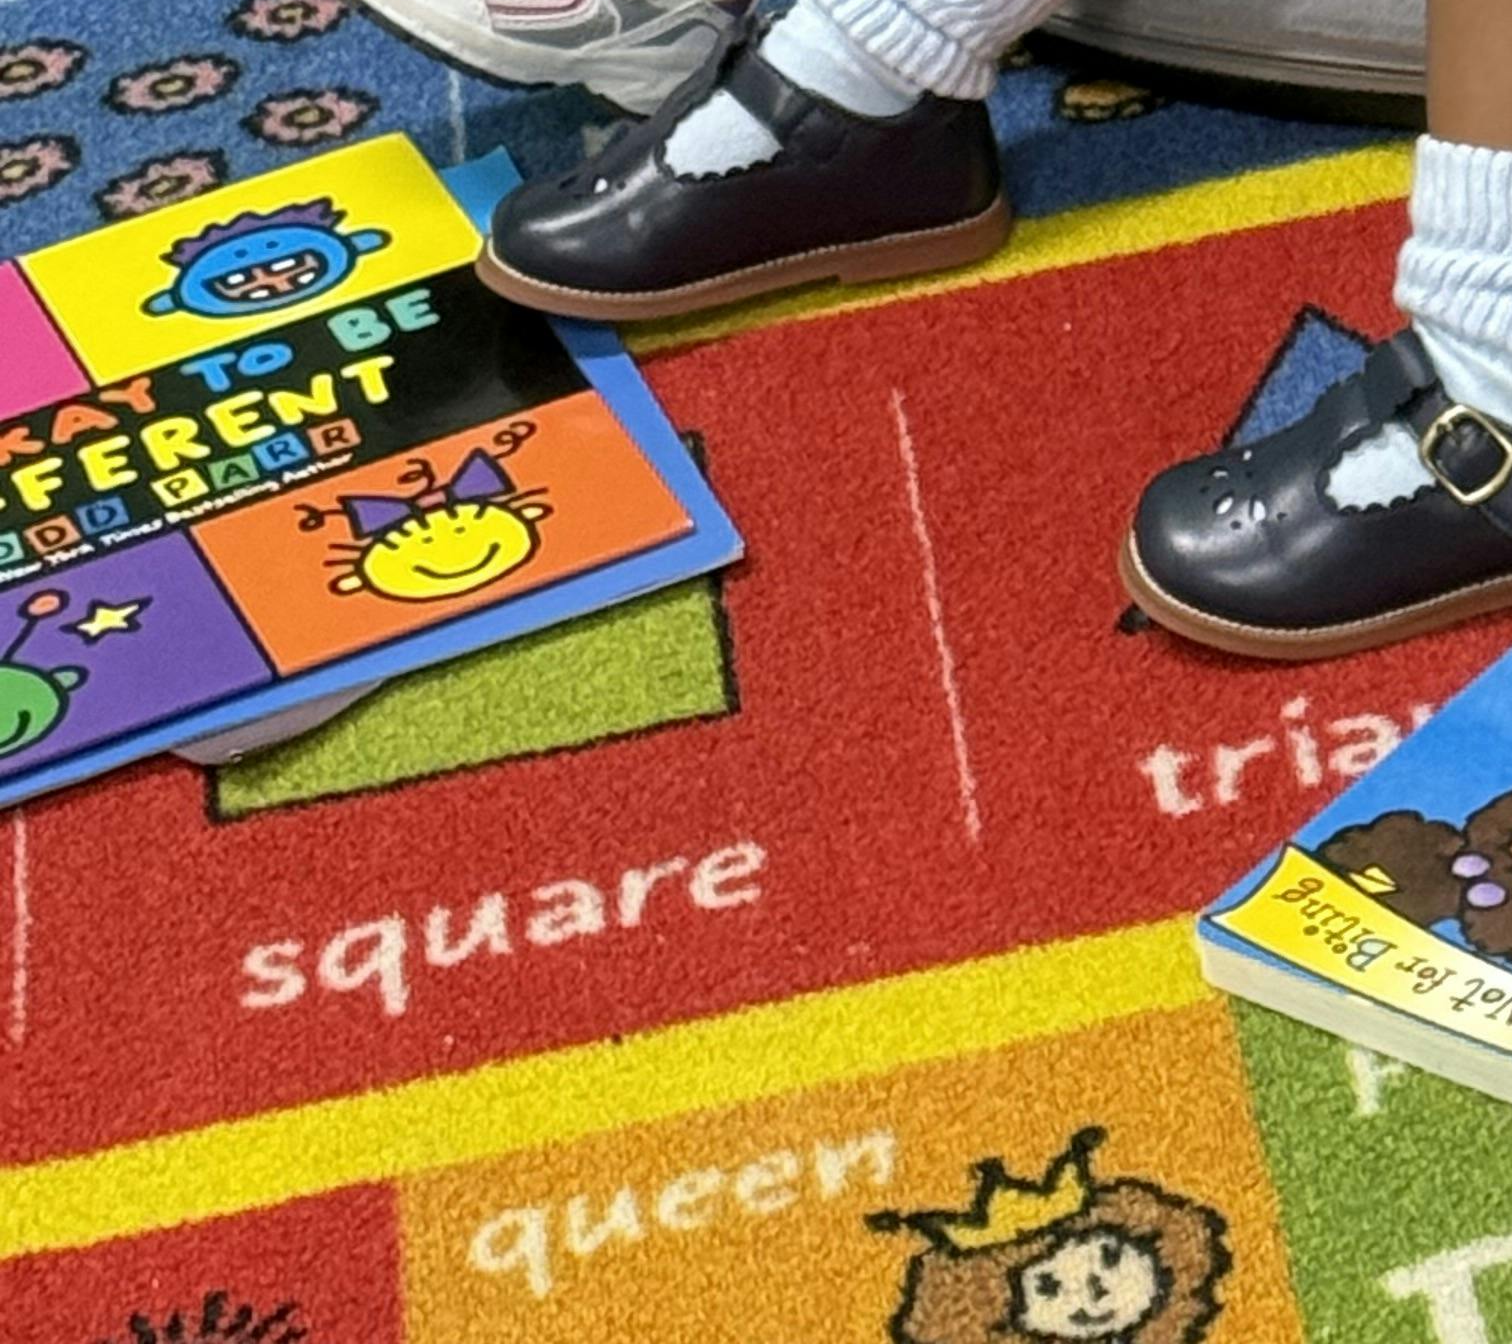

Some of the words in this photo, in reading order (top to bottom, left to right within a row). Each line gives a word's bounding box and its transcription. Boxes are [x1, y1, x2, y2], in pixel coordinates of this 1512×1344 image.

[180, 341, 294, 393] TO
[327, 287, 441, 353] BE
[0, 355, 395, 512] FERENT
[157, 420, 356, 503] PARR
[100, 519, 163, 545] Times
[281, 452, 353, 484] Author
[1138, 695, 1437, 819] tria
[240, 839, 767, 1016] square
[1271, 876, 1398, 973] Biting
[1394, 955, 1456, 995] for
[467, 1128, 897, 1298] queen
